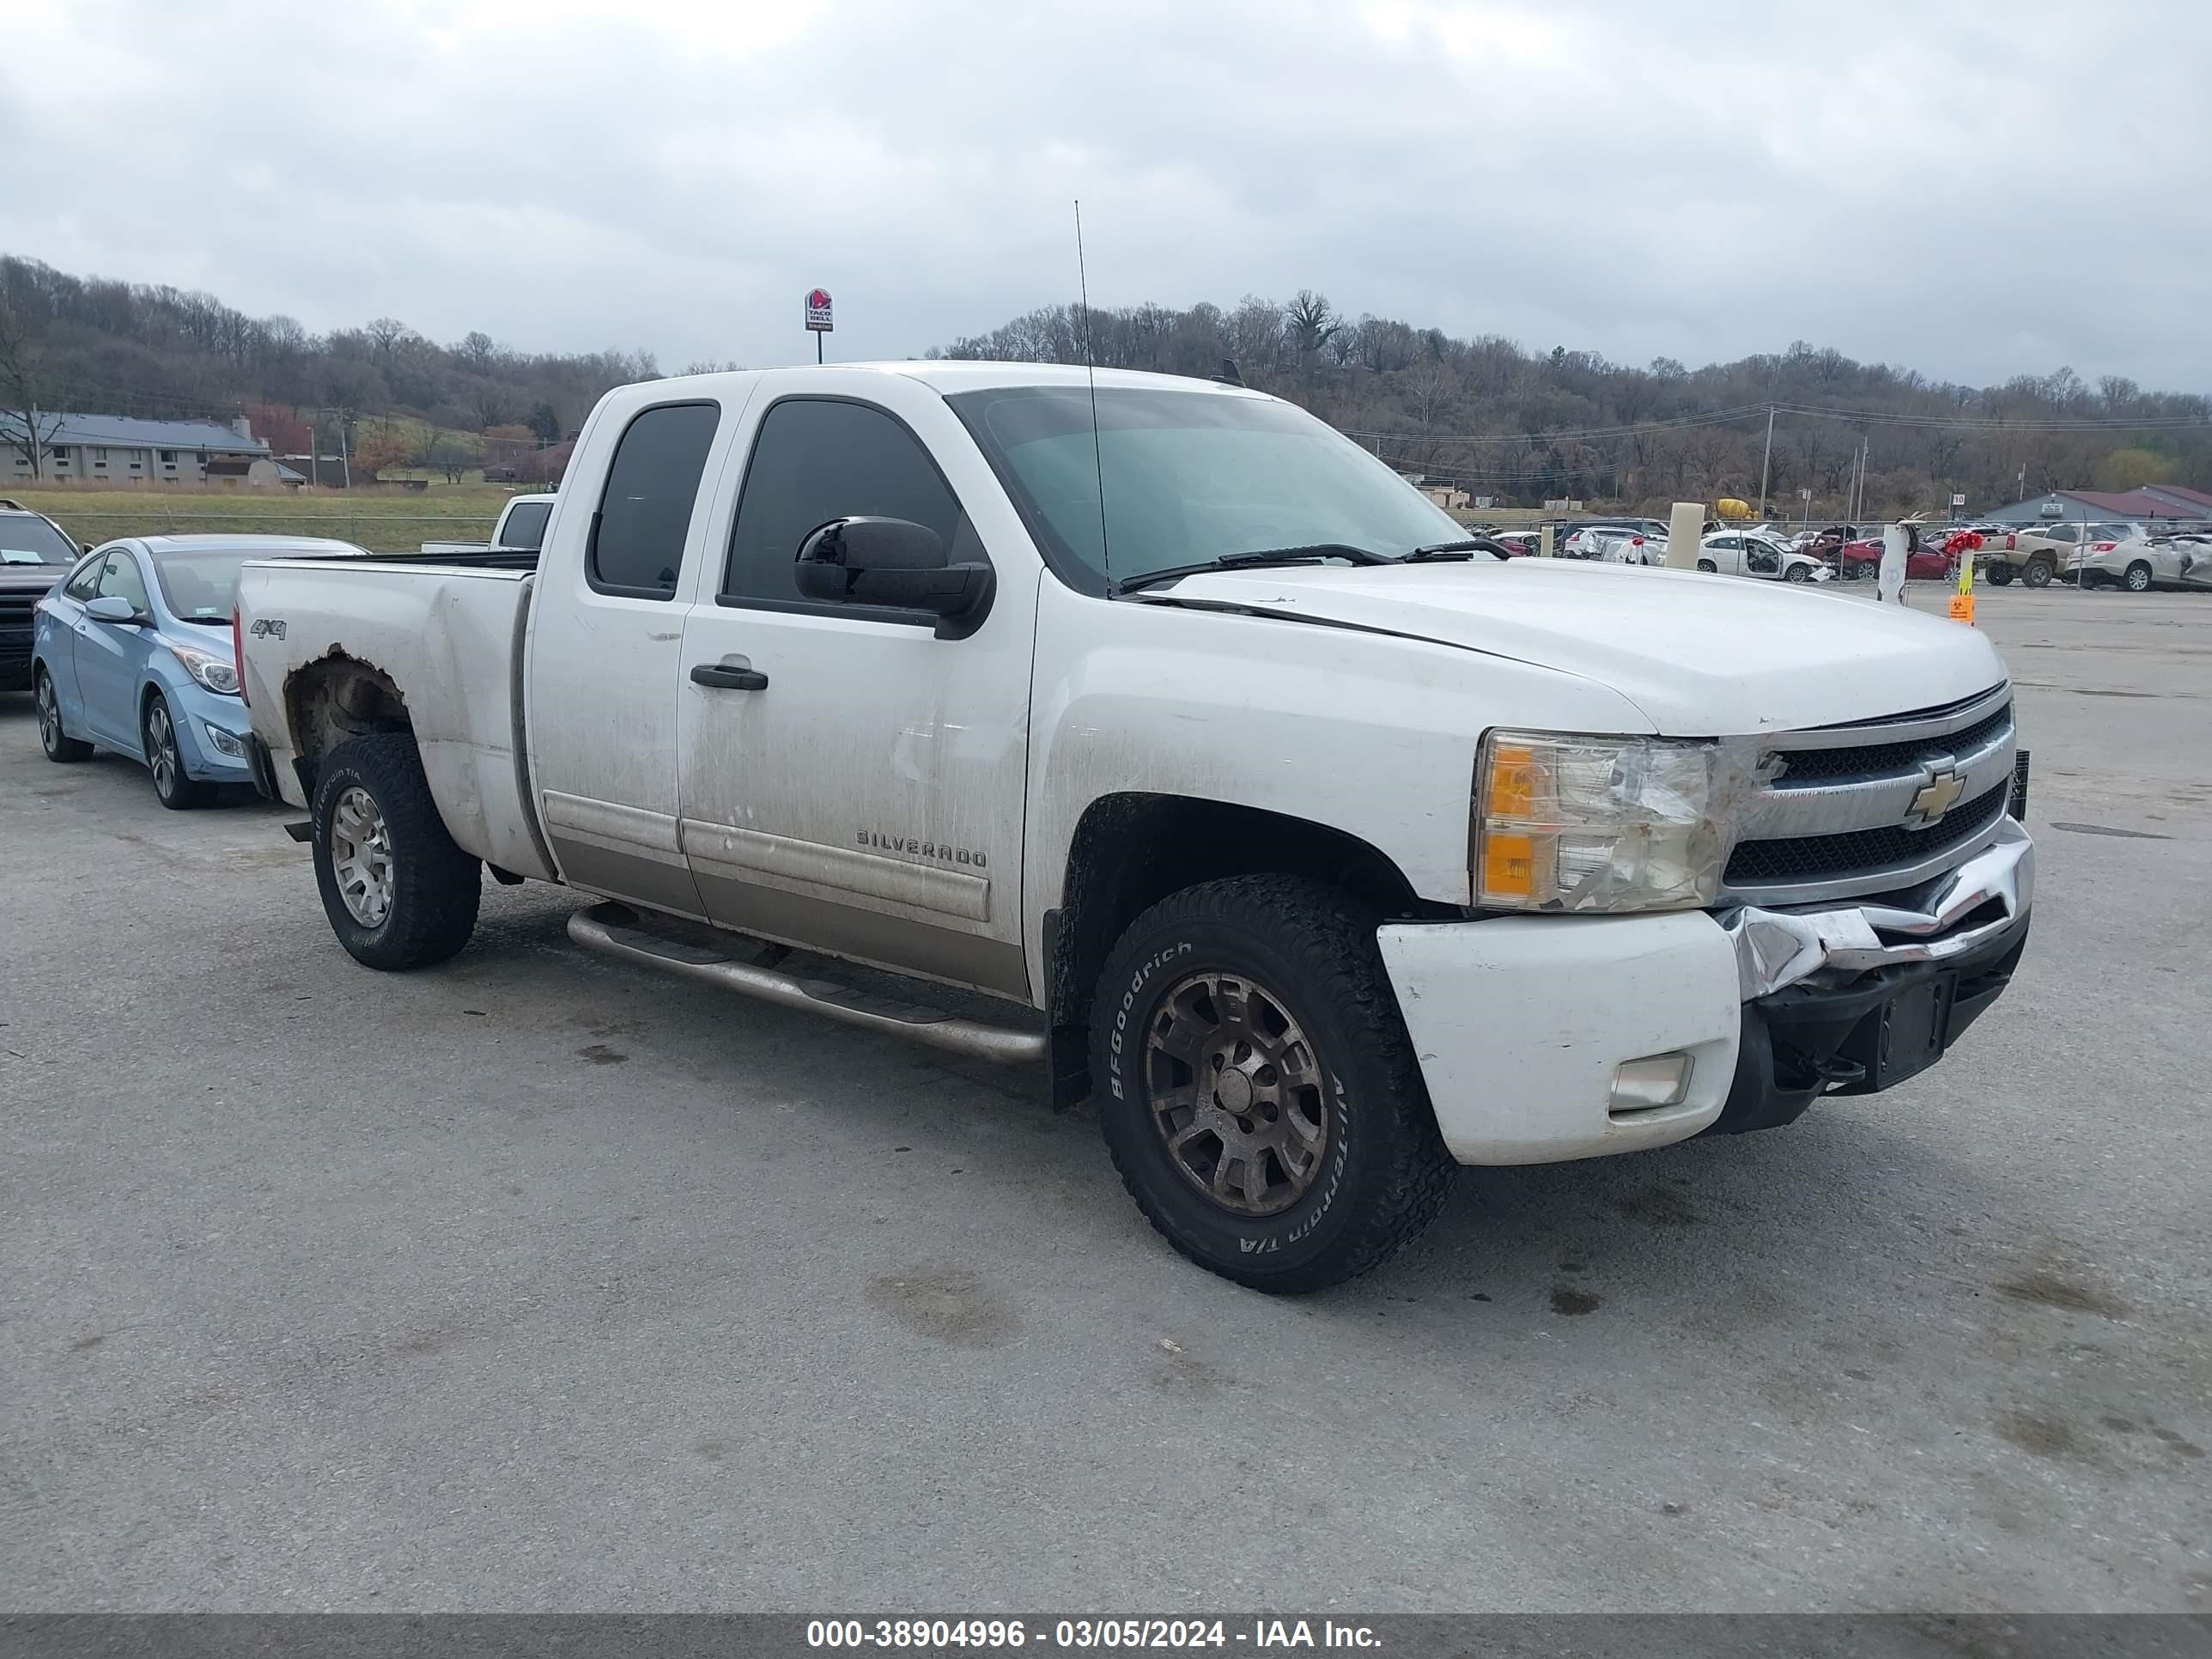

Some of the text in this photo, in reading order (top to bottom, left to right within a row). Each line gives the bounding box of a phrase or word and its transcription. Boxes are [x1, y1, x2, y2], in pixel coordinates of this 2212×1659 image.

[857, 830, 987, 867] SILVERADO
[1110, 941, 1192, 1100] BFGoodrich
[1240, 1072, 1348, 1255] All-Terrain T/A
